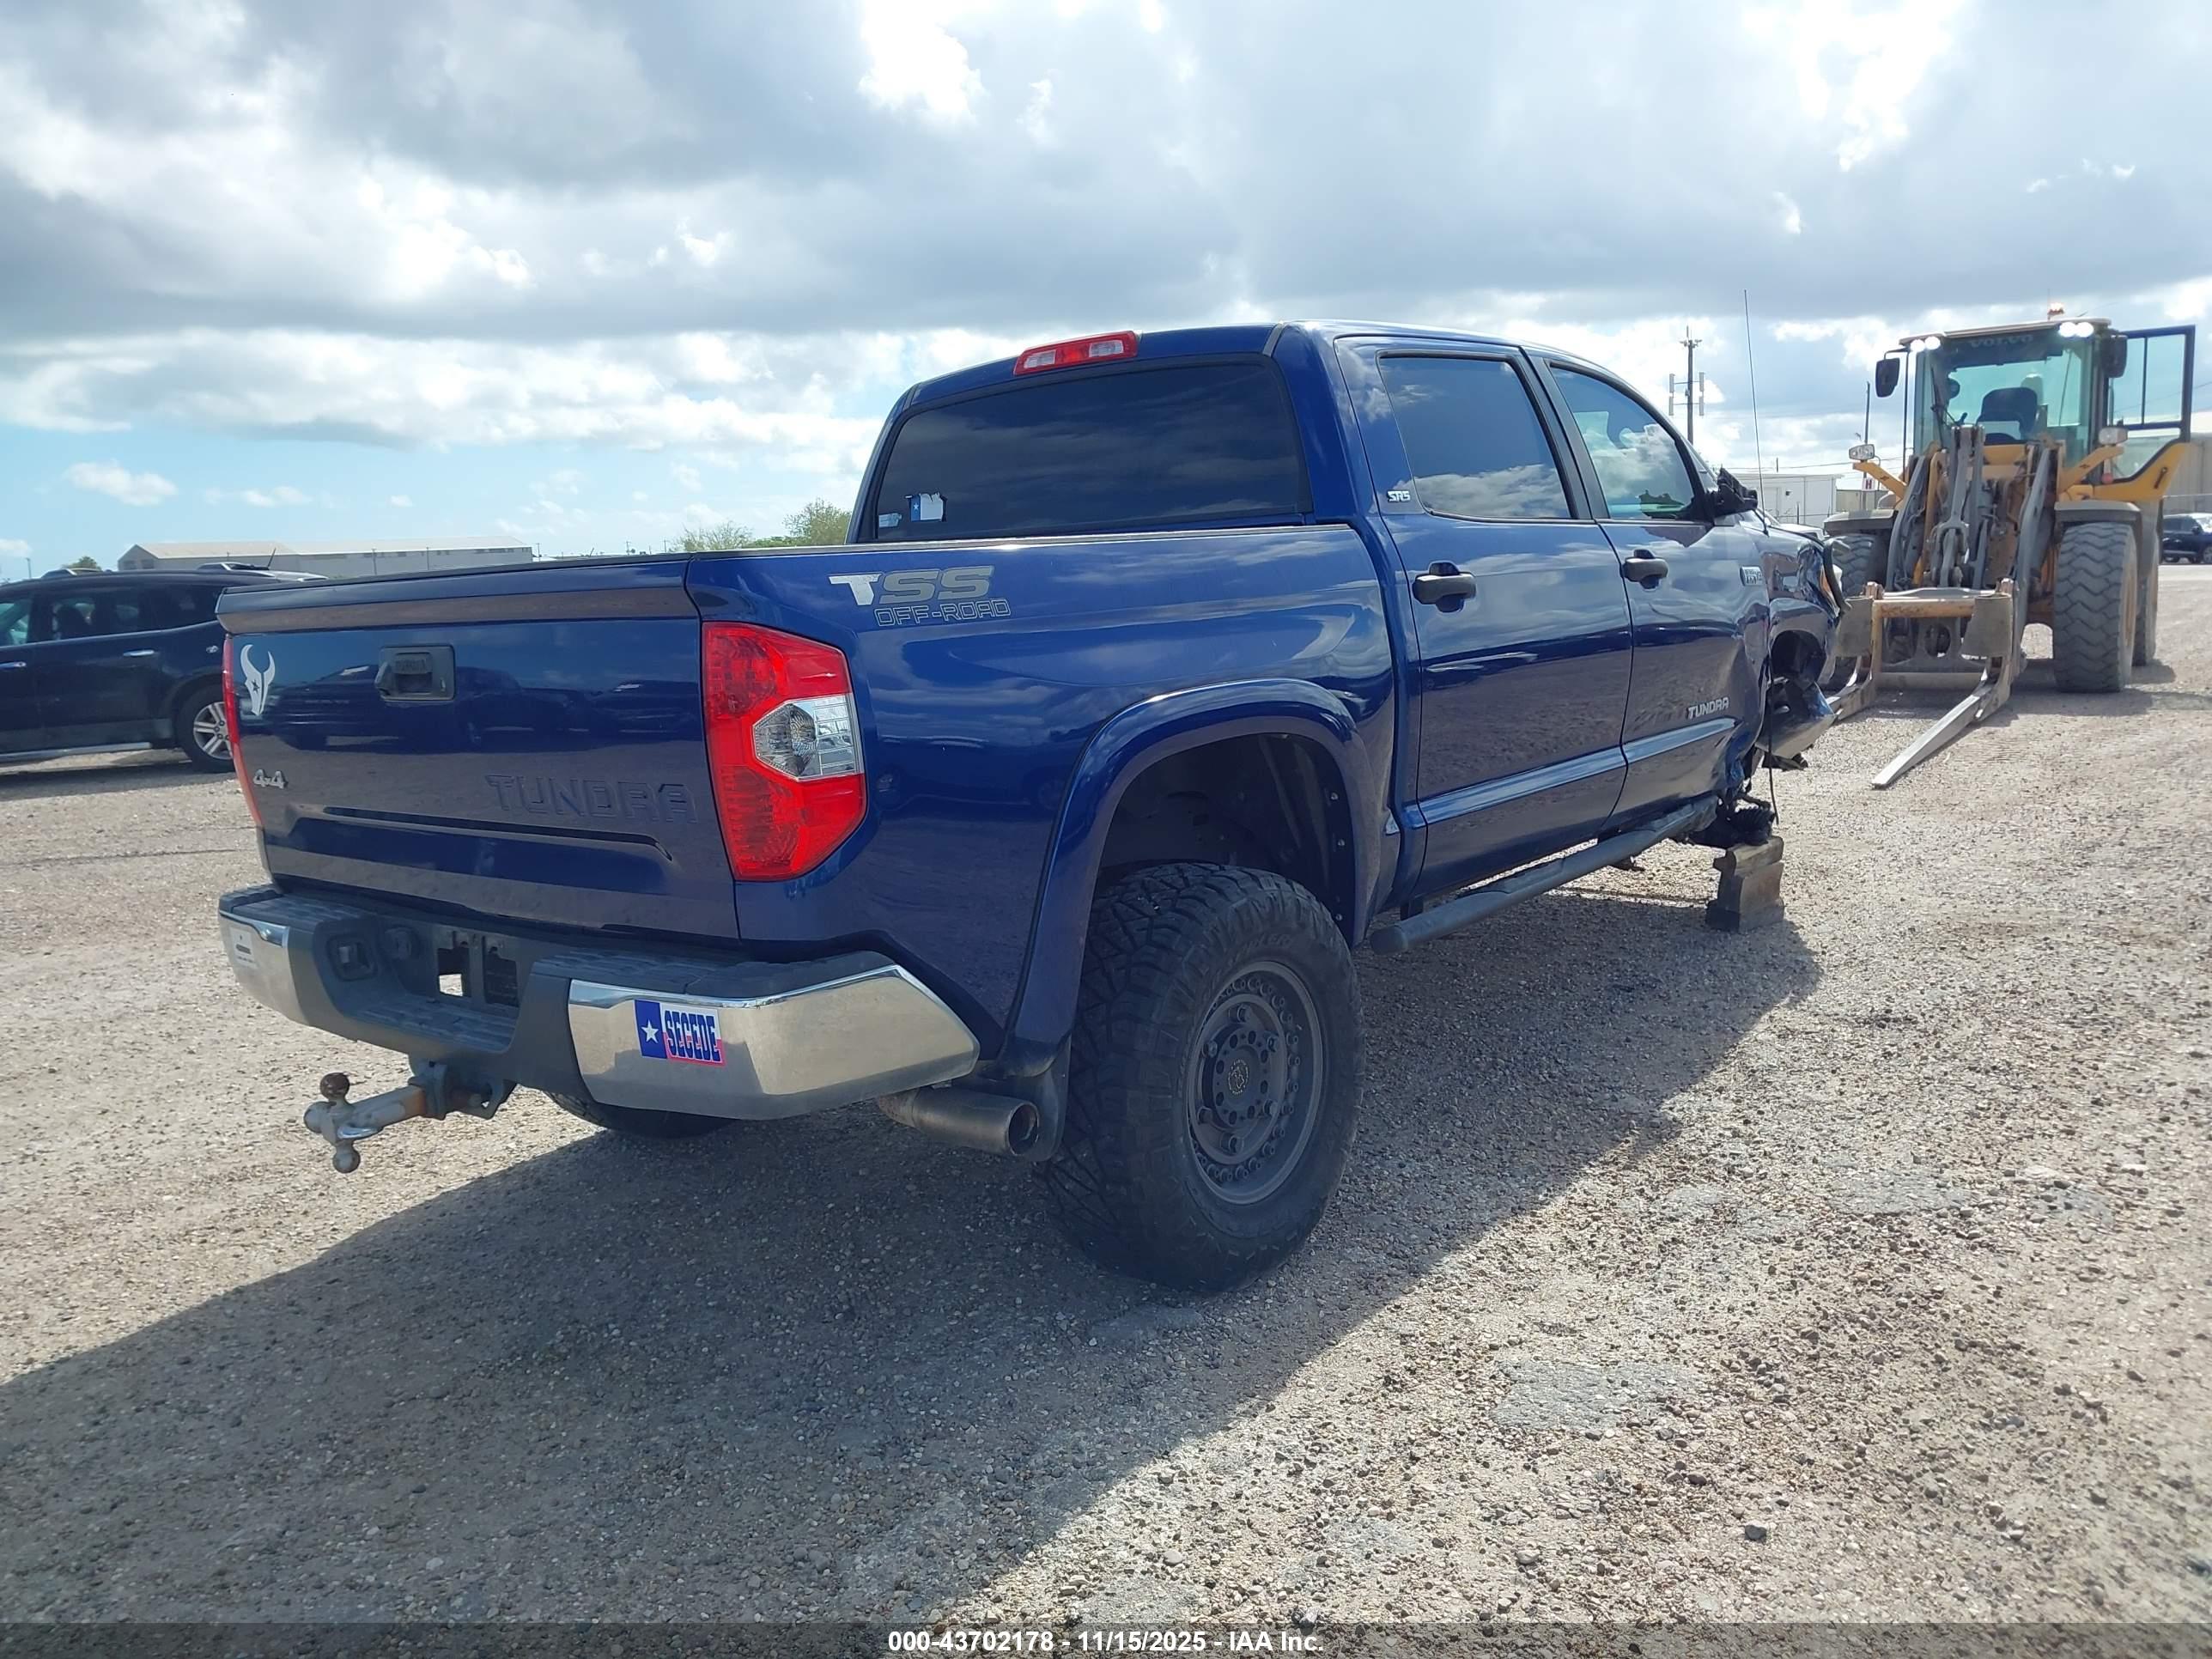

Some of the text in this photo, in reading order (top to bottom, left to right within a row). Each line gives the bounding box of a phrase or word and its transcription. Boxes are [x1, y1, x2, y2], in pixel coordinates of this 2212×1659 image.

[1387, 490, 1411, 502] SR5
[828, 565, 994, 606] TSS
[874, 598, 1012, 627] OFF-ROAD
[1688, 696, 1729, 720] TUNDRA
[483, 774, 699, 823] TUNDRA
[664, 1009, 722, 1062] SECEDE
